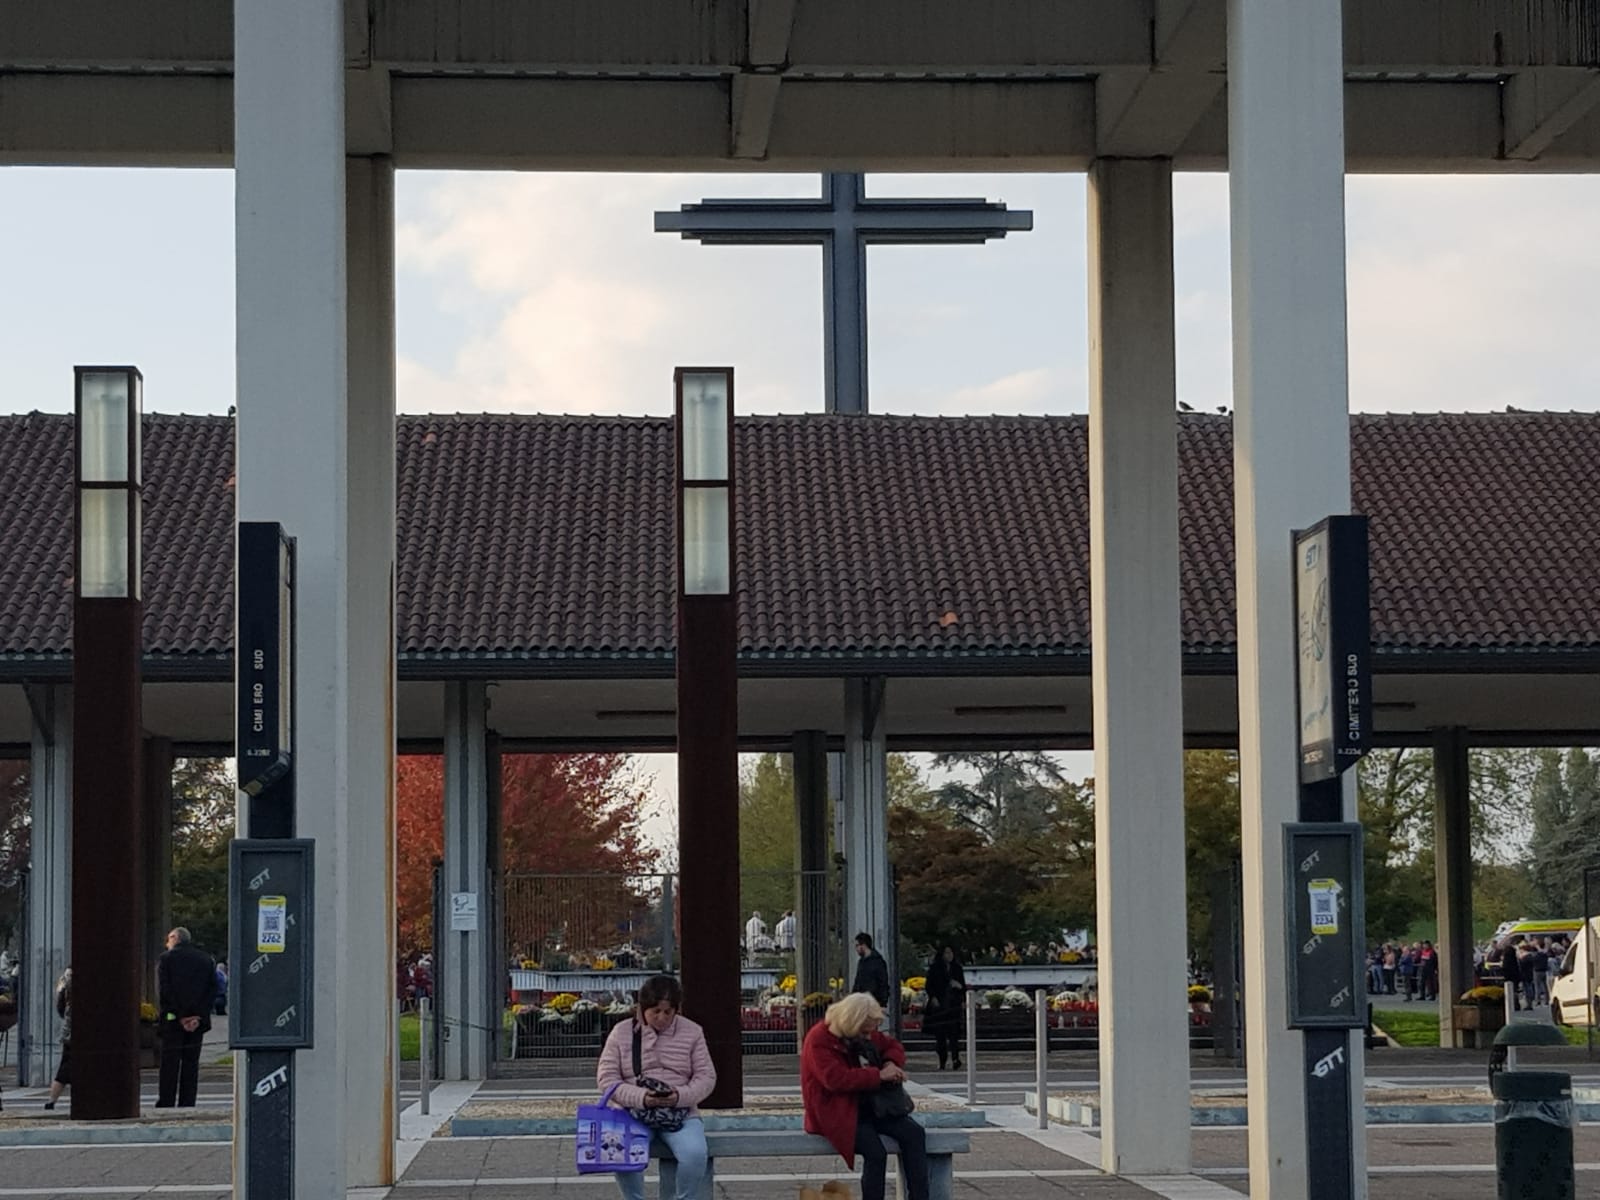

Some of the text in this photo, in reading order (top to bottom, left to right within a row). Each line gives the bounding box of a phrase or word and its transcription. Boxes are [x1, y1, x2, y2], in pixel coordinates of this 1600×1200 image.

[253, 649, 264, 670] SUD
[1347, 654, 1358, 676] SUD
[1300, 850, 1321, 873] GTT
[248, 867, 271, 891] GTT
[1329, 986, 1351, 1009] GTT
[274, 1004, 297, 1028] GTT
[1310, 1046, 1345, 1078] GTT
[253, 1065, 288, 1097] GTT
